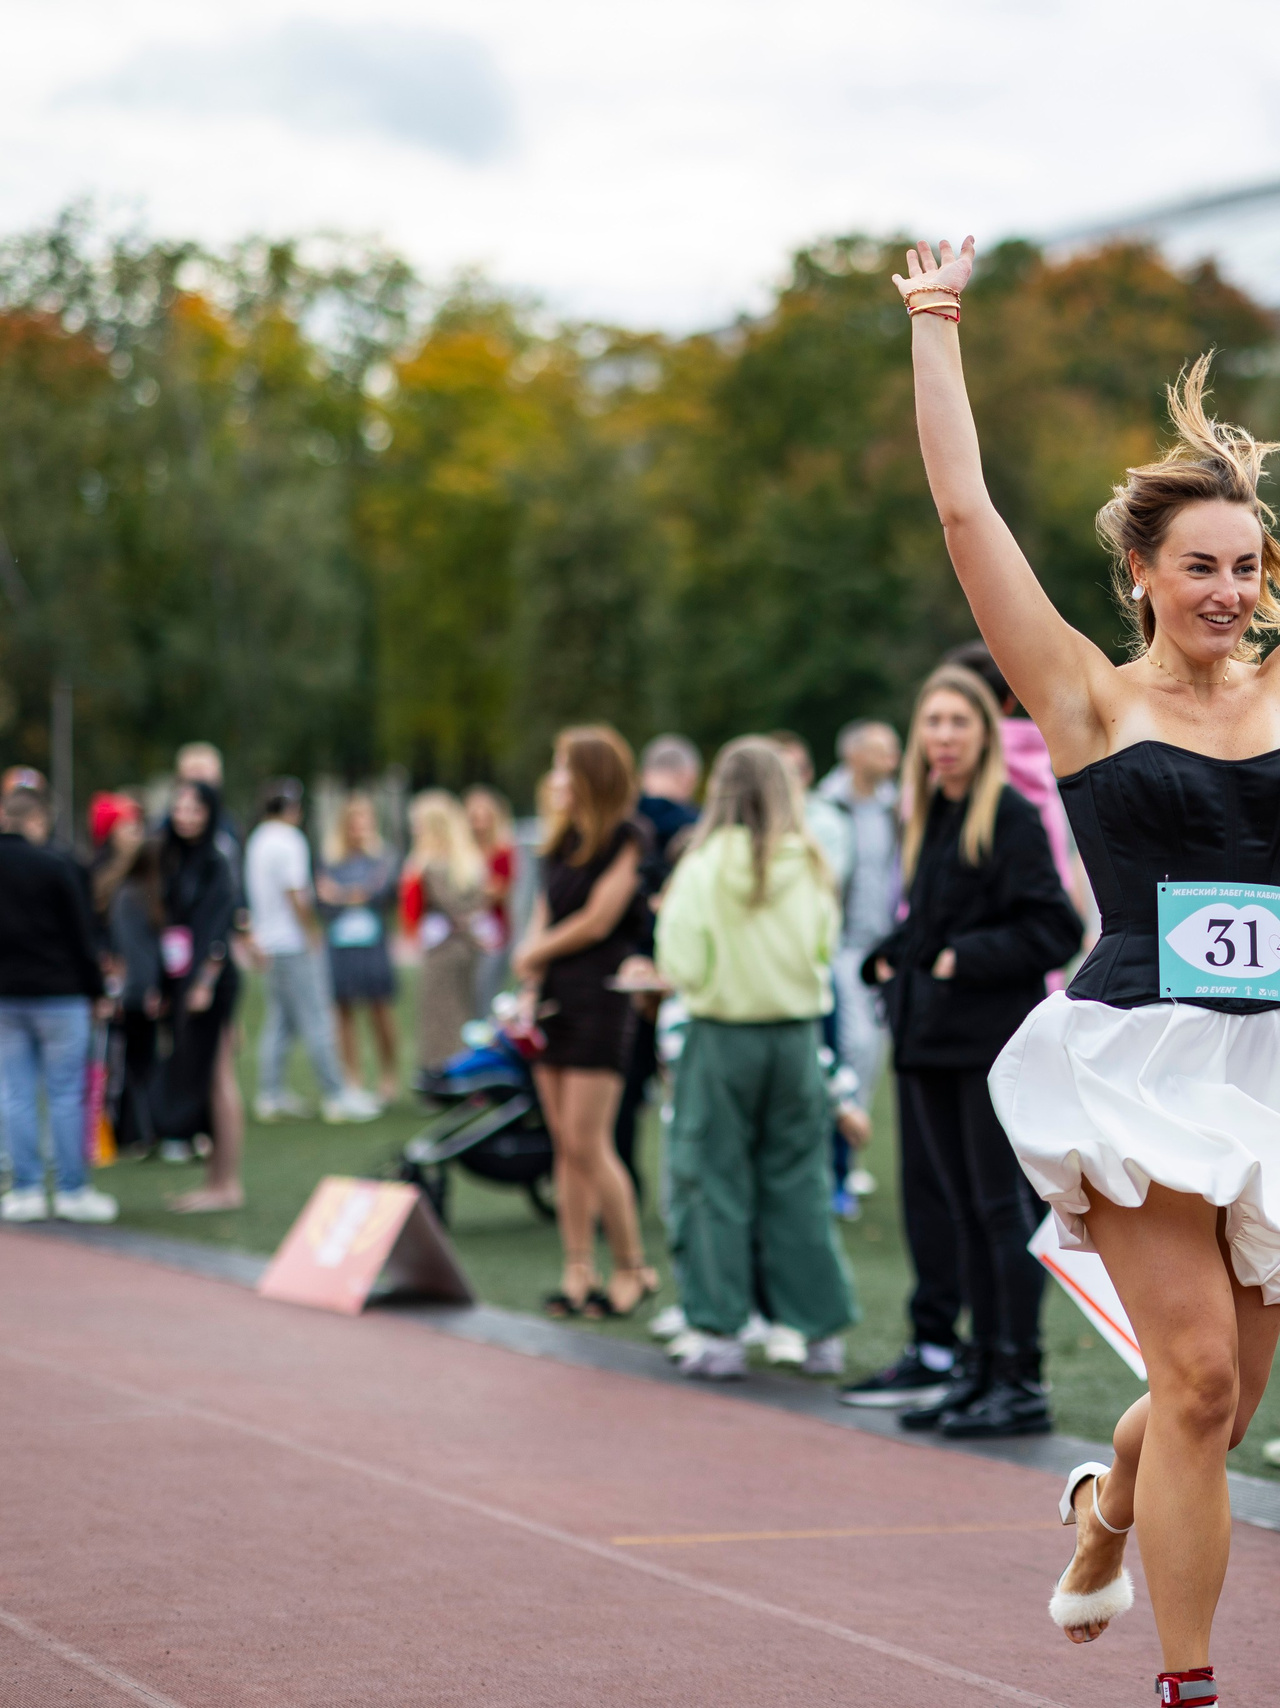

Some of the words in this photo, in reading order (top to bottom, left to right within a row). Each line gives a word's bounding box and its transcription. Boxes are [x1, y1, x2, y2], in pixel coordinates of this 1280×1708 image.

[1172, 887, 1217, 896] ЖЕНСКИЙ
[1218, 889, 1243, 898] ЗАБЕГ
[1244, 890, 1256, 898] НА
[1205, 918, 1264, 968] 31
[1195, 986, 1209, 994] DD
[1209, 986, 1237, 994] EVENT
